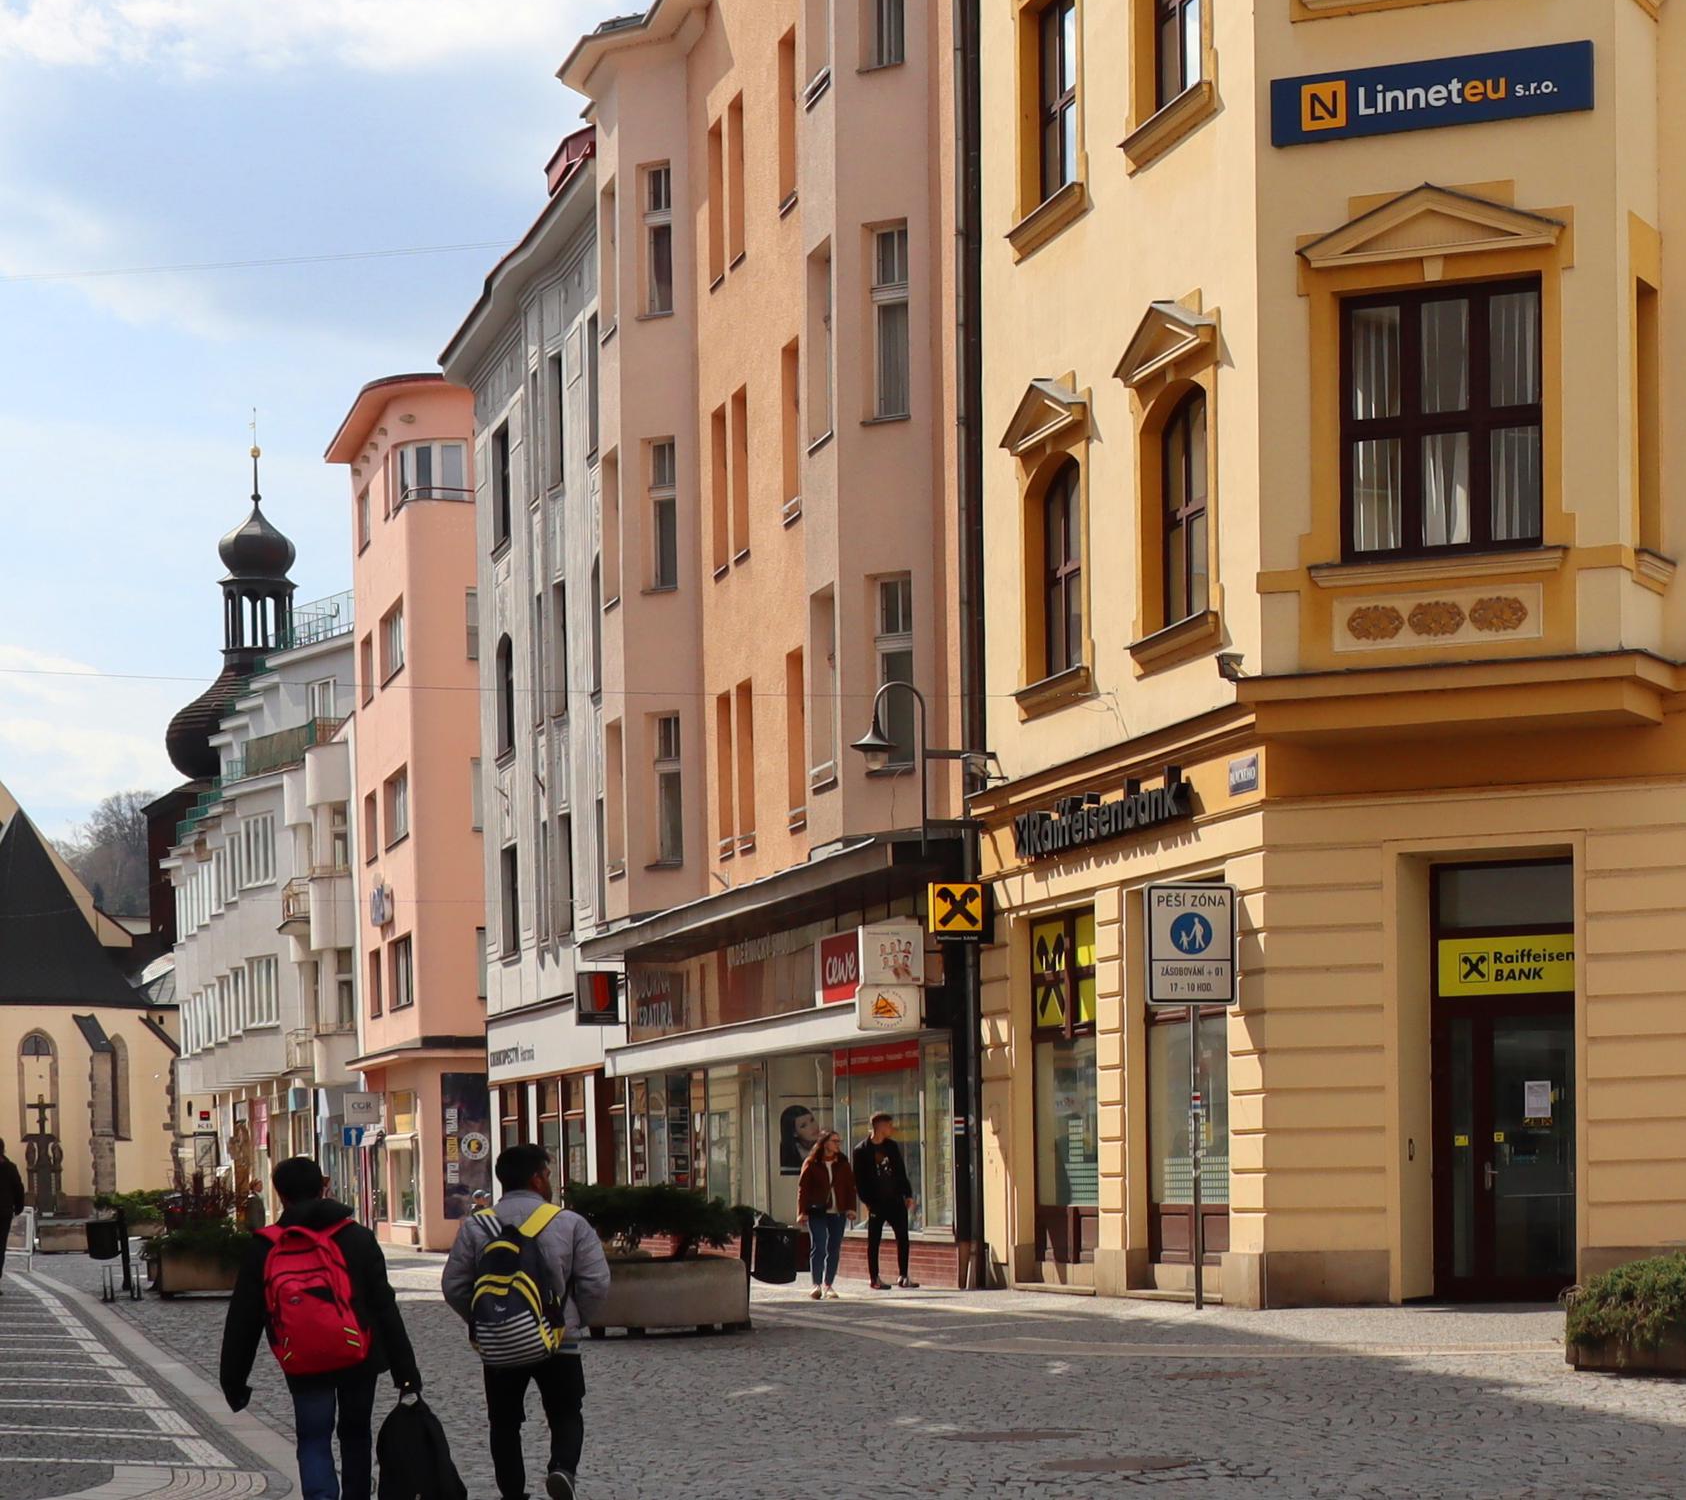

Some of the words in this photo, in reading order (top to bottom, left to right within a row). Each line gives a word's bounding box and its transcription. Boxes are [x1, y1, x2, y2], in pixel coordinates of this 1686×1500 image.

[1358, 76, 1507, 116] Linneteu
[1514, 79, 1558, 98] s.r.o.
[1029, 766, 1191, 856] Raiffeisenbank
[1157, 893, 1187, 908] PĚŠÍ
[1191, 894, 1226, 908] ZÓNA
[1493, 948, 1575, 964] Raiffeisen
[825, 952, 856, 985] cewe
[1161, 965, 1205, 976] ZÁSOBOVÁNÍ
[1494, 966, 1544, 982] BANK
[1170, 982, 1177, 992] 17
